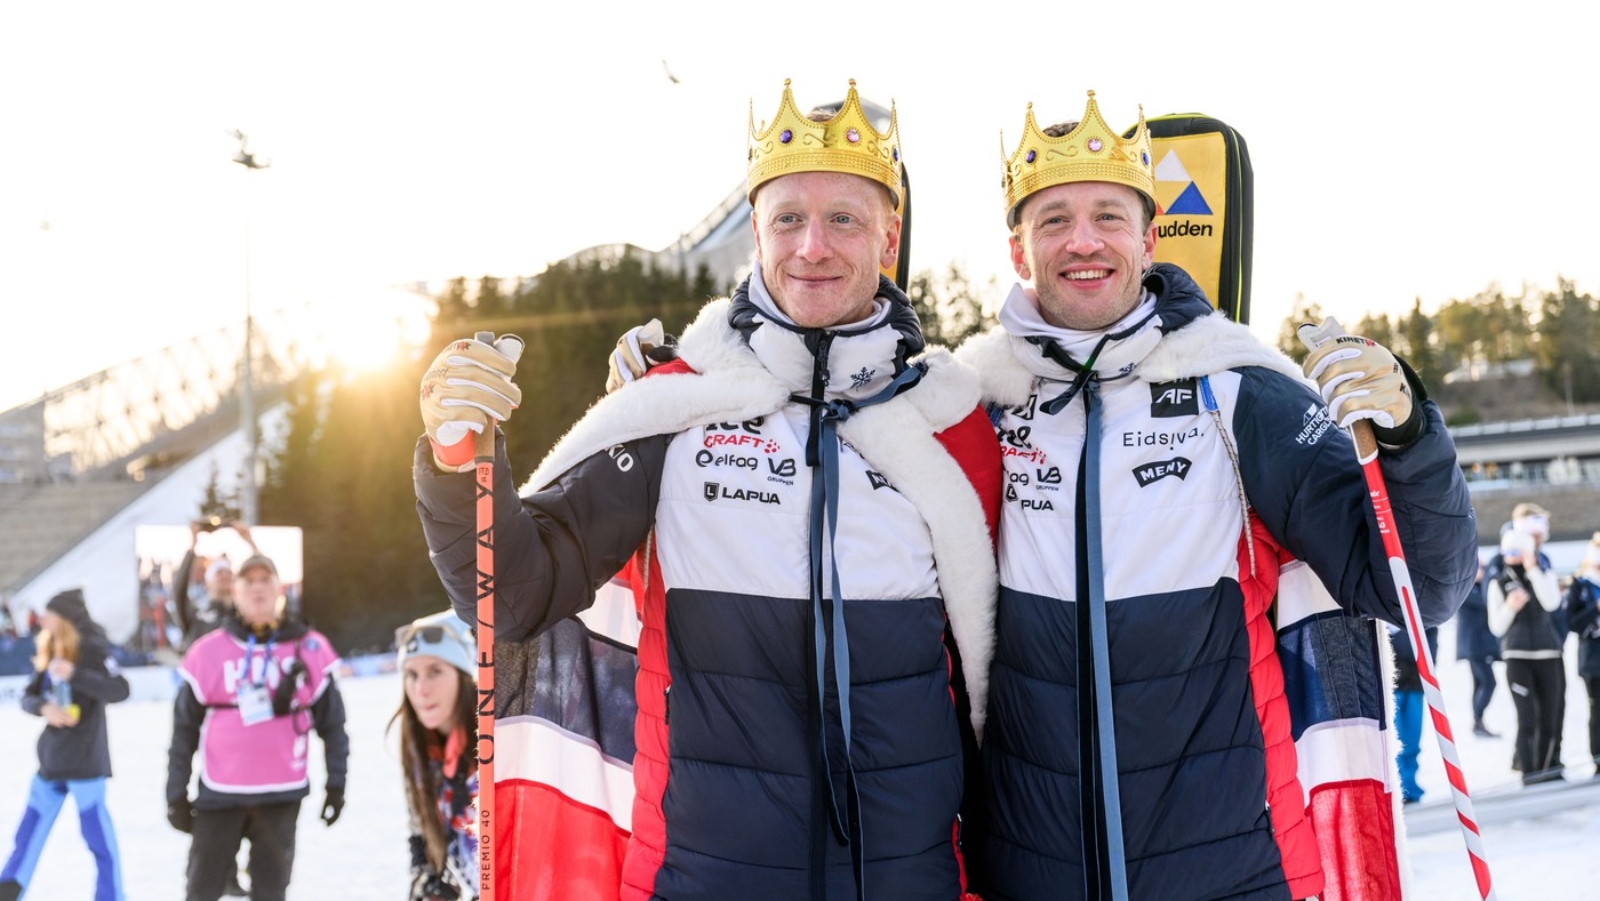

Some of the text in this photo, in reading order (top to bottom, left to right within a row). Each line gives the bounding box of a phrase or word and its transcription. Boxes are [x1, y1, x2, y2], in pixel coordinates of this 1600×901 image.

[1158, 220, 1213, 238] udden
[703, 434, 765, 449] CRAFT
[714, 453, 758, 471] elfag
[1140, 461, 1187, 481] MENY
[722, 487, 781, 505] LAPUA
[1021, 499, 1054, 511] PUA
[481, 810, 490, 890] PREMIO 40
